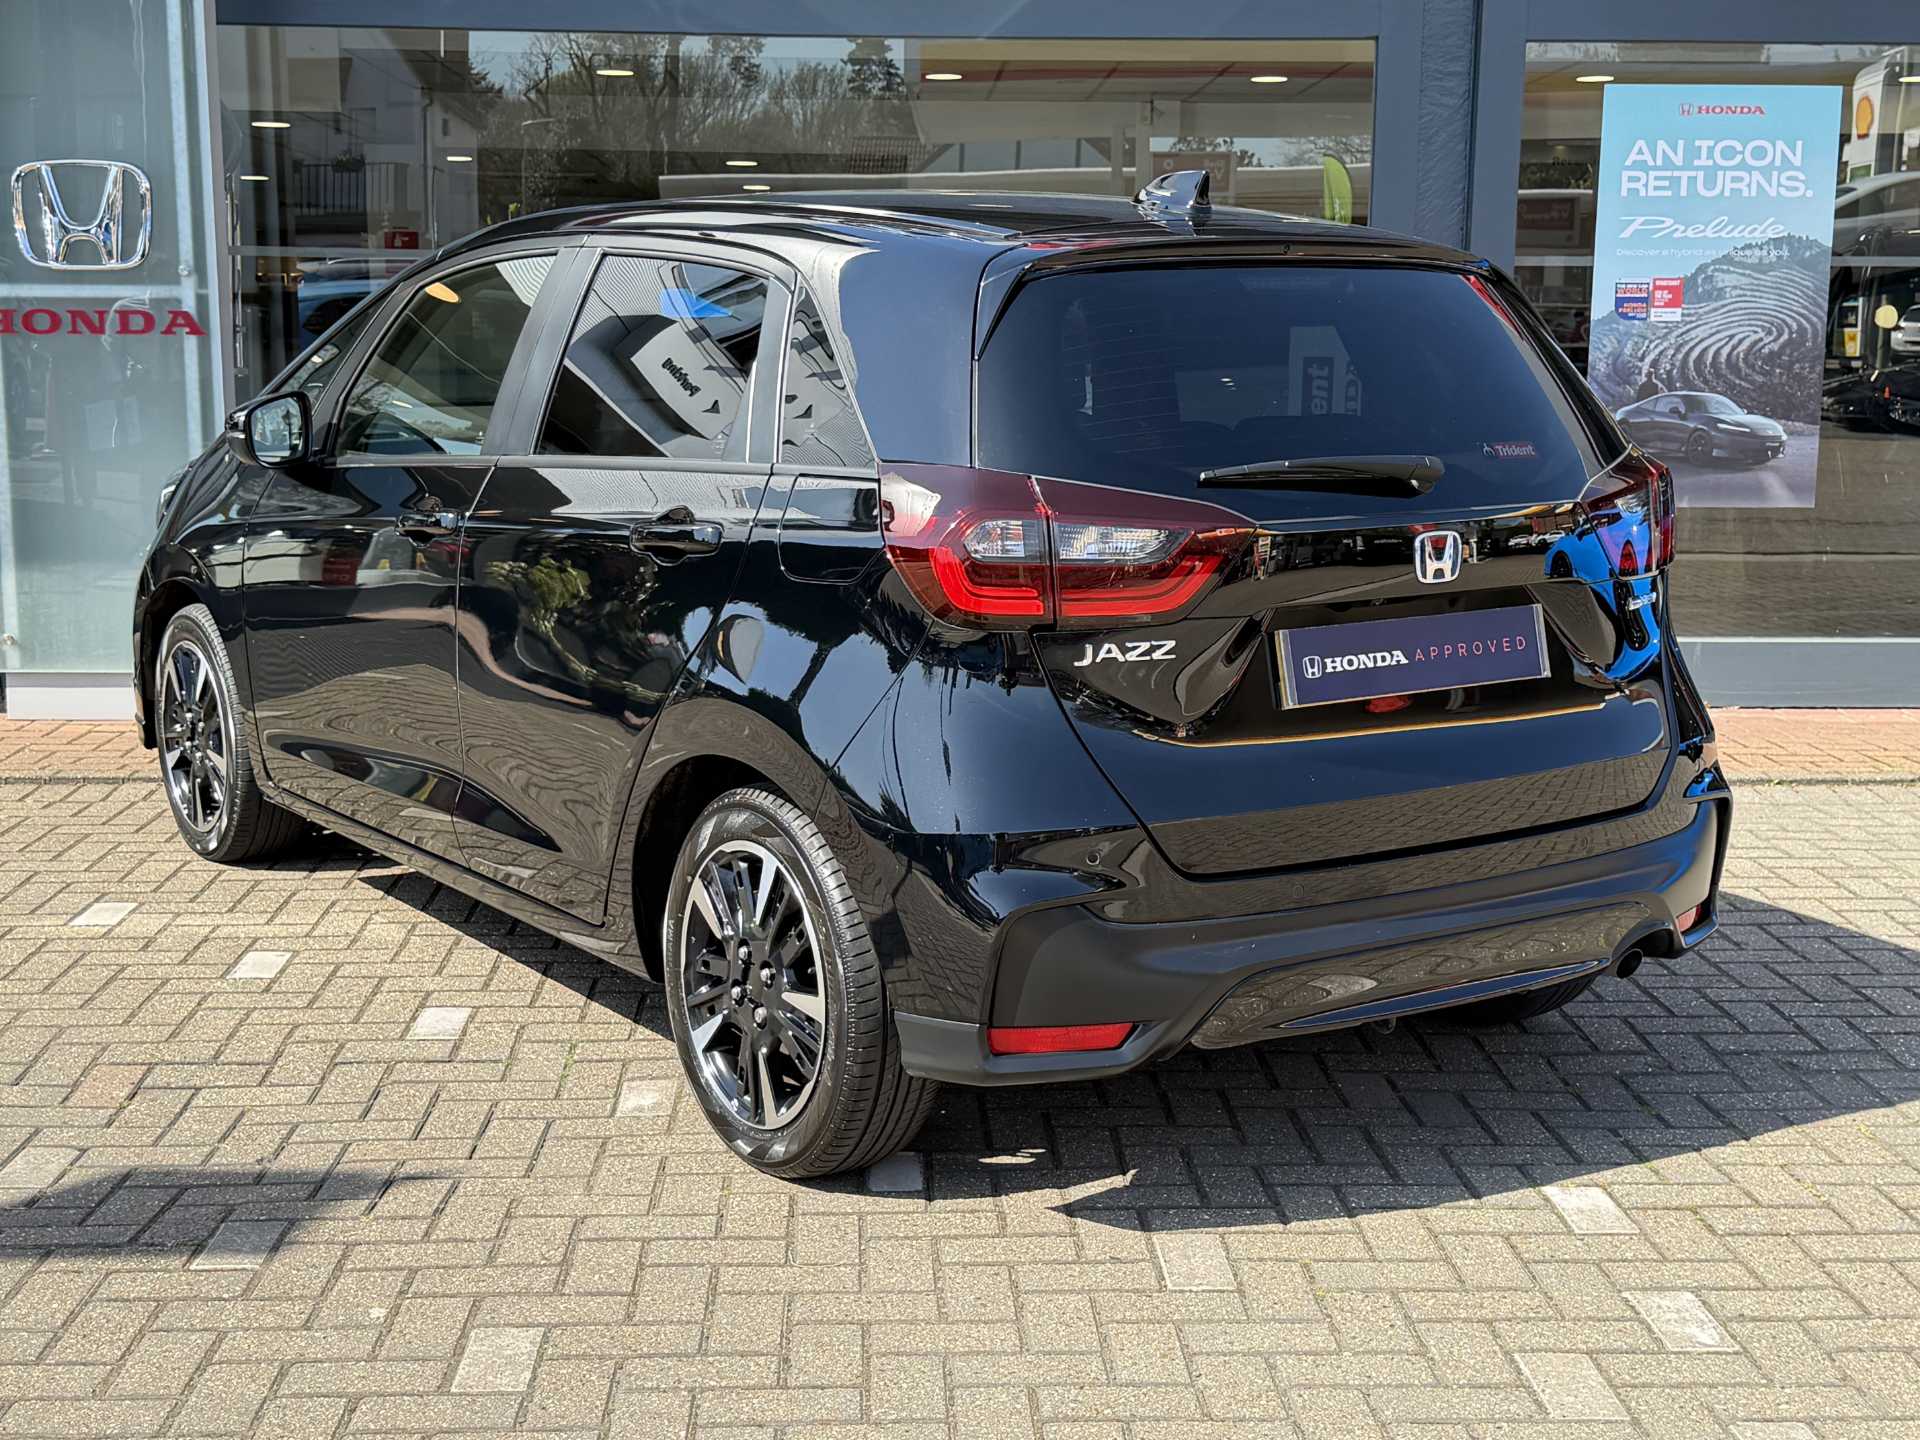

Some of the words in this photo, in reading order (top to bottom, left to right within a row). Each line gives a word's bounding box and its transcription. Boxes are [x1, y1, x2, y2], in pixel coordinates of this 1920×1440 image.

[1697, 105, 1766, 115] HONDA
[1624, 139, 1685, 167] AN
[1693, 139, 1804, 167] ICON
[1620, 170, 1815, 198] RETURNS.
[1618, 216, 1788, 239] Prelude
[1495, 444, 1536, 457] Trident
[1073, 640, 1177, 667] JAZZ
[1324, 650, 1409, 673] HONDA
[1415, 636, 1527, 662] APPROVED
